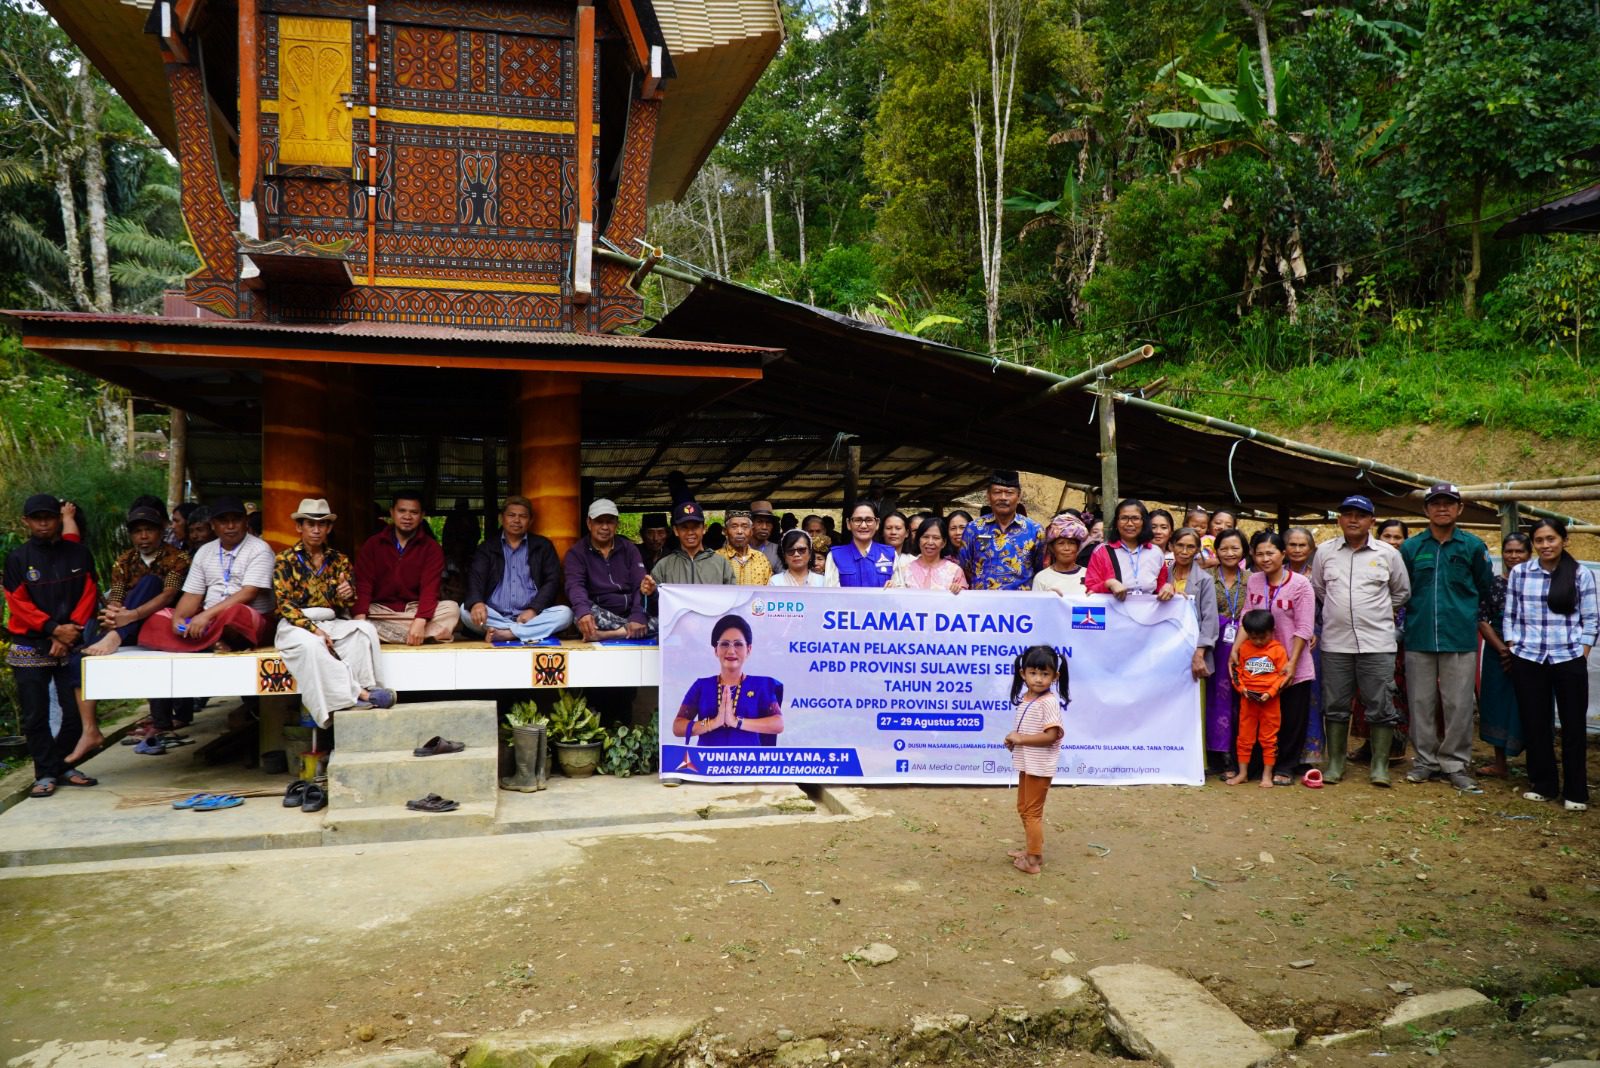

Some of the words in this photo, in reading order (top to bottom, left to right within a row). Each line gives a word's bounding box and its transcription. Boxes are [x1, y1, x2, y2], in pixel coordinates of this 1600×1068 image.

[767, 601, 805, 612] DPRD
[822, 610, 929, 632] SELAMAT
[935, 613, 1033, 634] DATANG
[789, 641, 860, 654] KEGIATAN
[864, 642, 967, 656] PELAKSANAAN
[809, 660, 846, 673] APBD
[850, 661, 916, 674] PROVINSI
[920, 662, 990, 675] SULAWESI
[884, 680, 932, 693] TAHUN
[936, 681, 973, 693] 2025
[790, 698, 853, 709] ANGGOTA
[856, 699, 887, 709] DPRD
[891, 699, 948, 710] PROVINSI
[952, 700, 1012, 711] SULAWESI
[880, 717, 891, 726] 27
[900, 717, 912, 726] 29
[914, 718, 955, 729] Agustus
[956, 718, 980, 727] 2025
[698, 752, 757, 762] YUNIANA
[760, 752, 826, 764] MULYANA,
[829, 753, 849, 762] S.H
[707, 765, 742, 775] FRAKSI
[744, 765, 780, 775] PARTAI
[782, 765, 839, 775] DEMOKRAT
[911, 763, 927, 771] ANA
[929, 763, 953, 771] Media
[954, 764, 980, 772] Center
